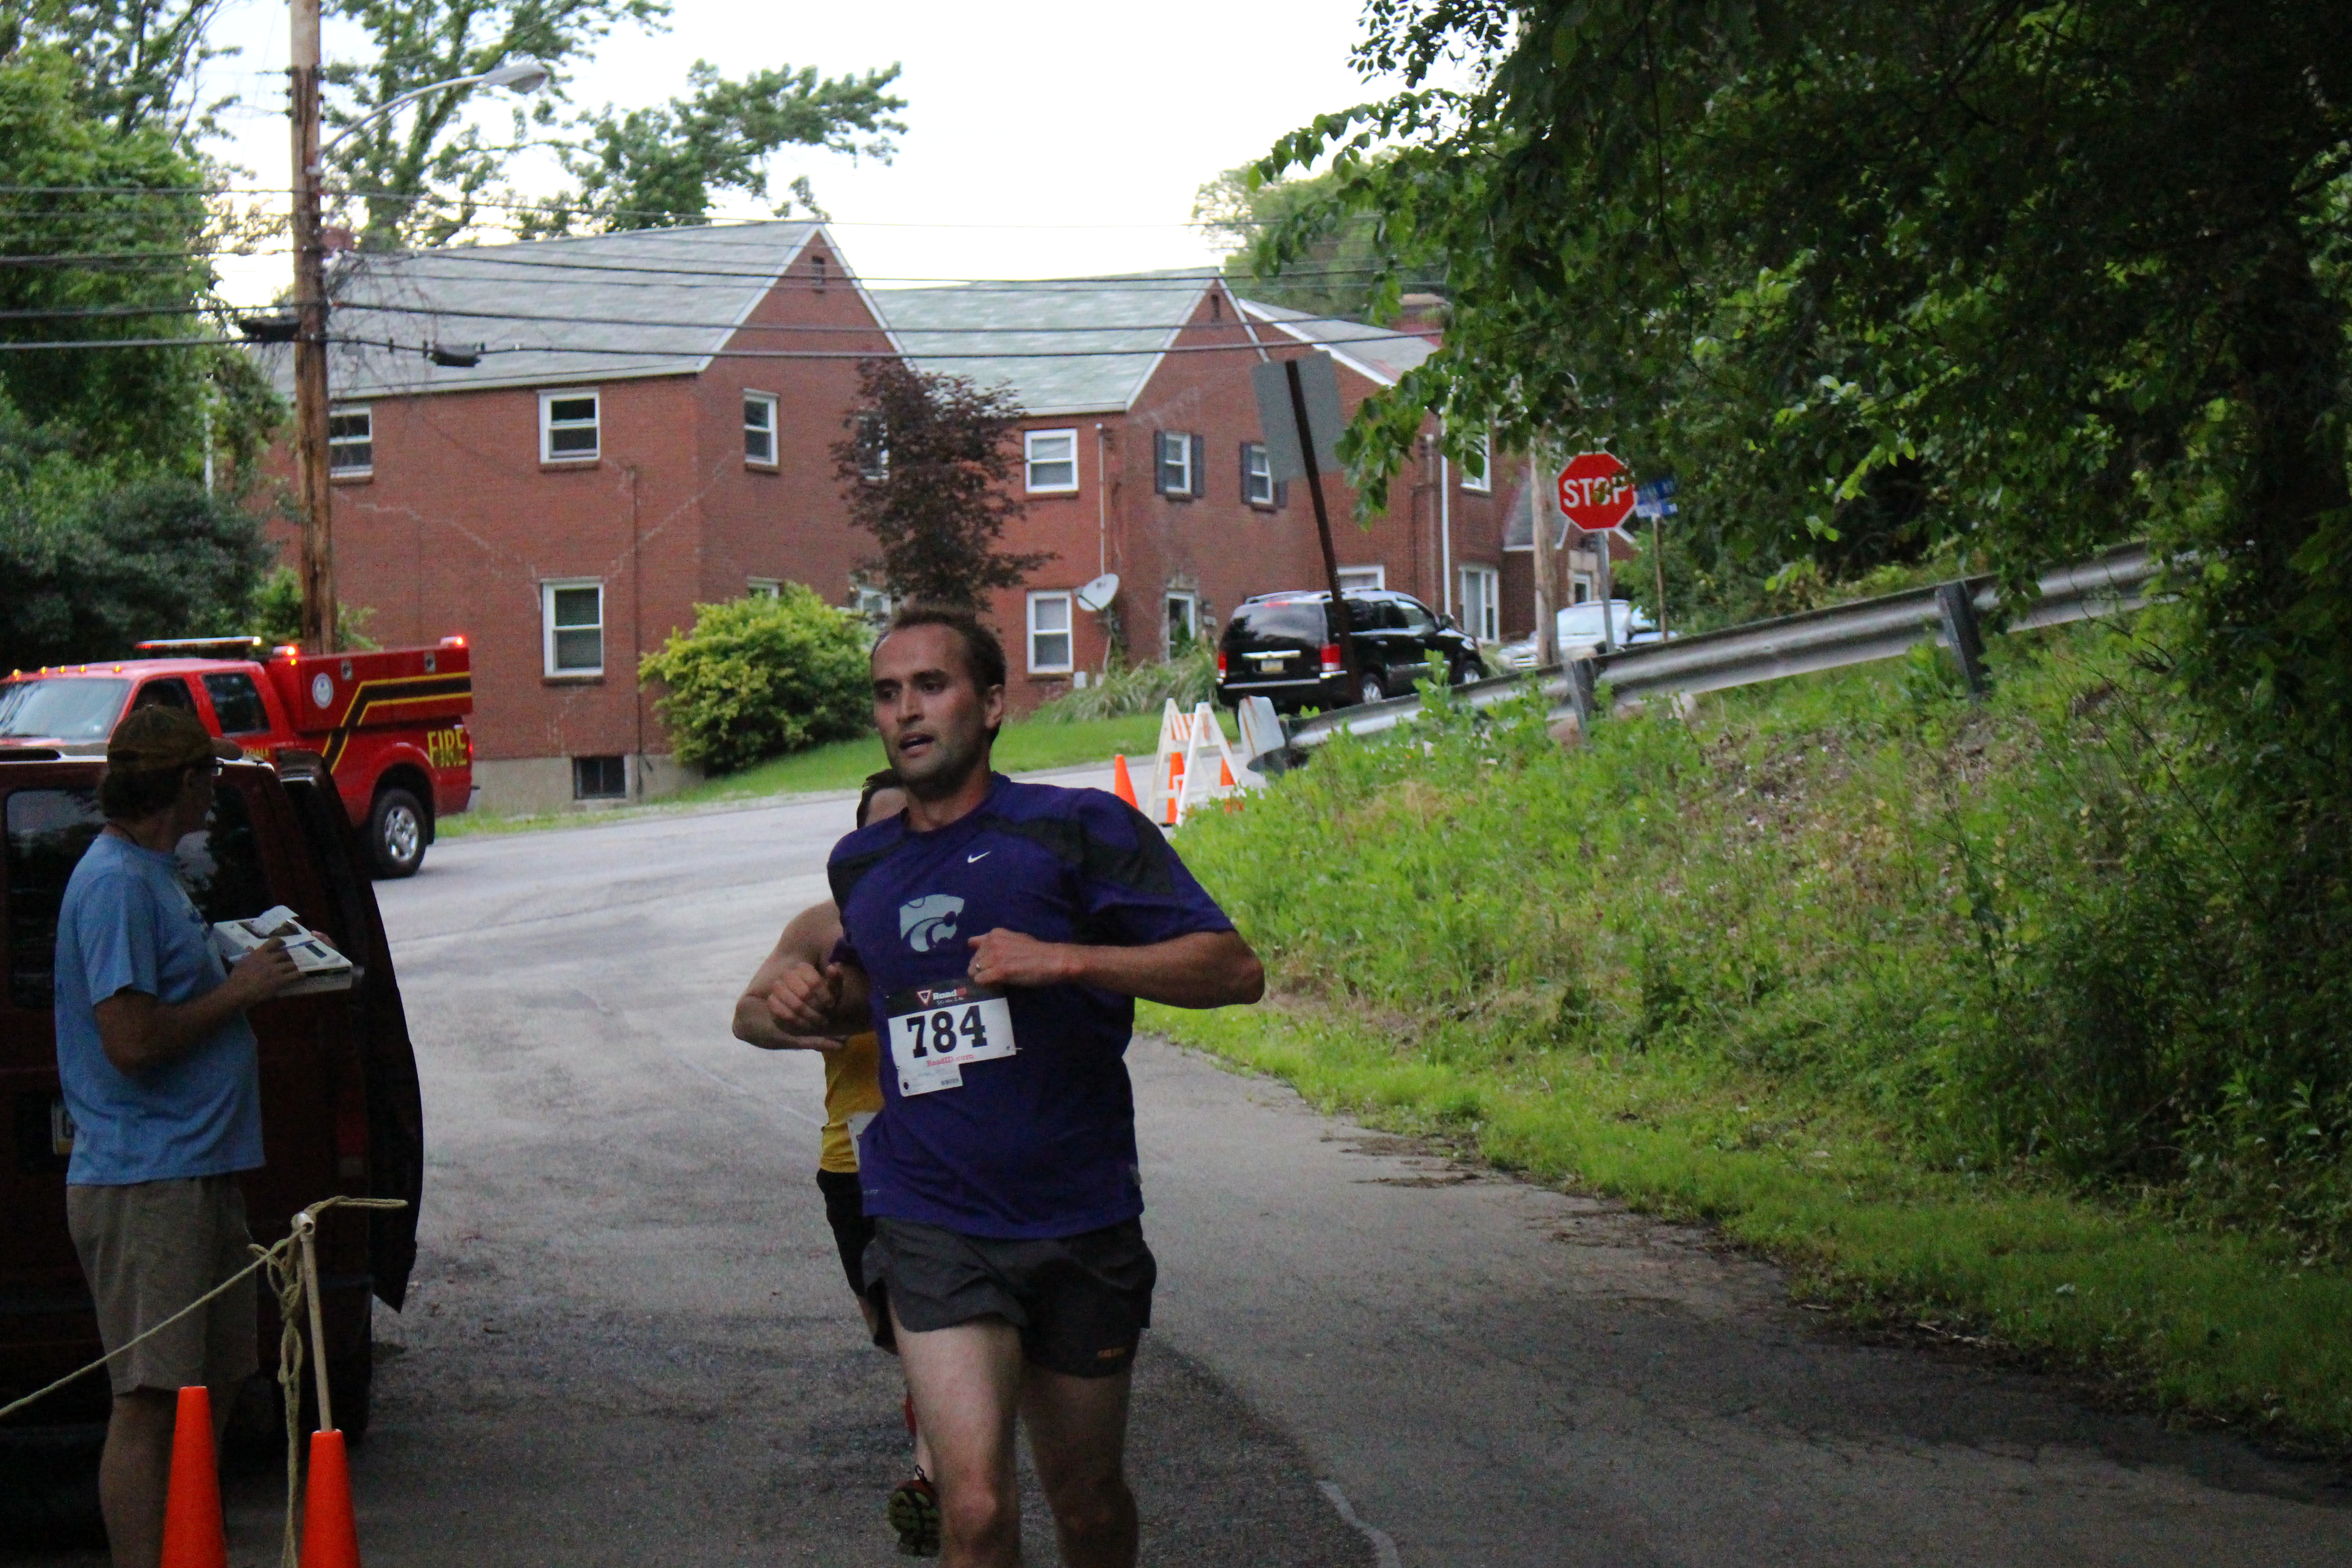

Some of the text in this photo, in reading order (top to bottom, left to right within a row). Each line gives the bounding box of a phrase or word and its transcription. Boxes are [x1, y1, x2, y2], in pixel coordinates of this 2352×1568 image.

[1563, 477, 1629, 508] STOP
[427, 727, 467, 767] FIRE
[906, 1005, 987, 1058] 784
